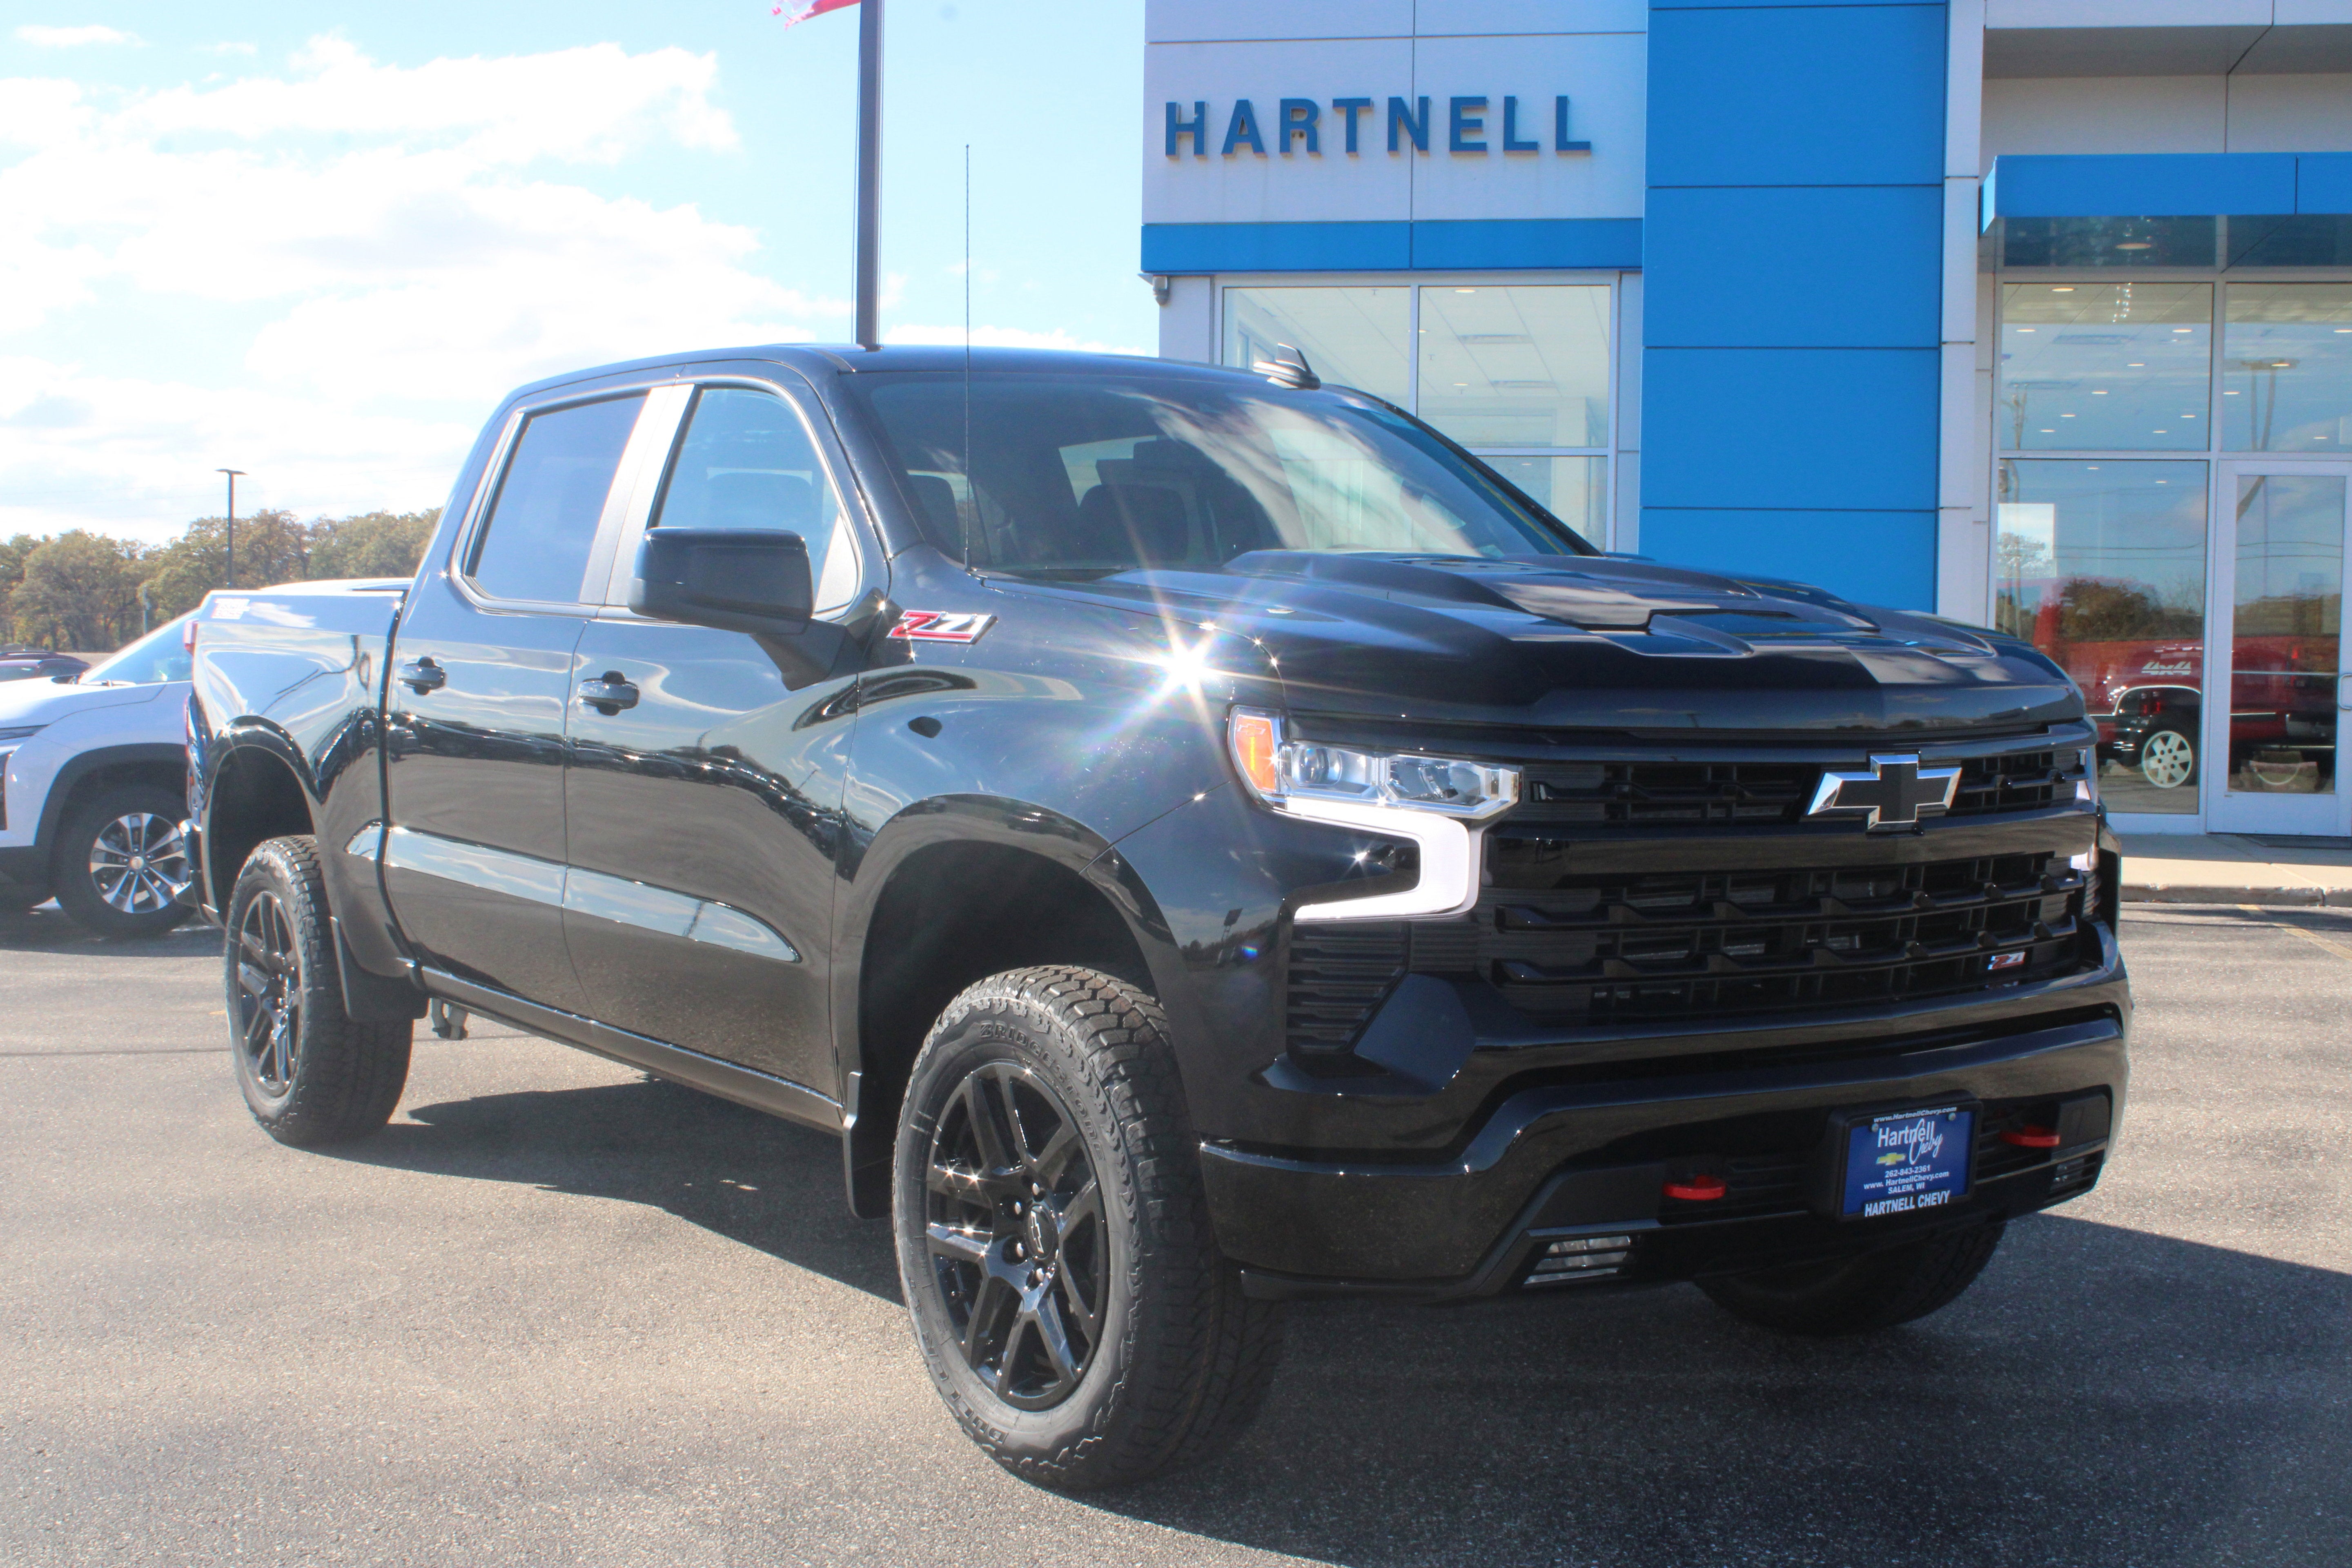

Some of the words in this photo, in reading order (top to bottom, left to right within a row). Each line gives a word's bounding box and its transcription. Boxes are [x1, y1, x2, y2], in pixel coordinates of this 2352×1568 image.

[1165, 95, 1591, 158] HARTNELL
[885, 610, 994, 644] Z71
[980, 1020, 1106, 1161] BRIDGESTONE
[1873, 1107, 1957, 1123] www.HartnellChevy.com
[1878, 1121, 1935, 1147] Hartnell
[1909, 1118, 1943, 1165] Chevy
[1863, 1181, 1884, 1189] www.
[1885, 1171, 1949, 1186] HartnellChevy.com
[1884, 1164, 1931, 1178] 262-843-2361
[1888, 1183, 1914, 1194] SALEM,
[1916, 1181, 1925, 1190] WI
[1864, 1196, 1915, 1217] HARTNELL
[1917, 1190, 1951, 1208] CHEVY
